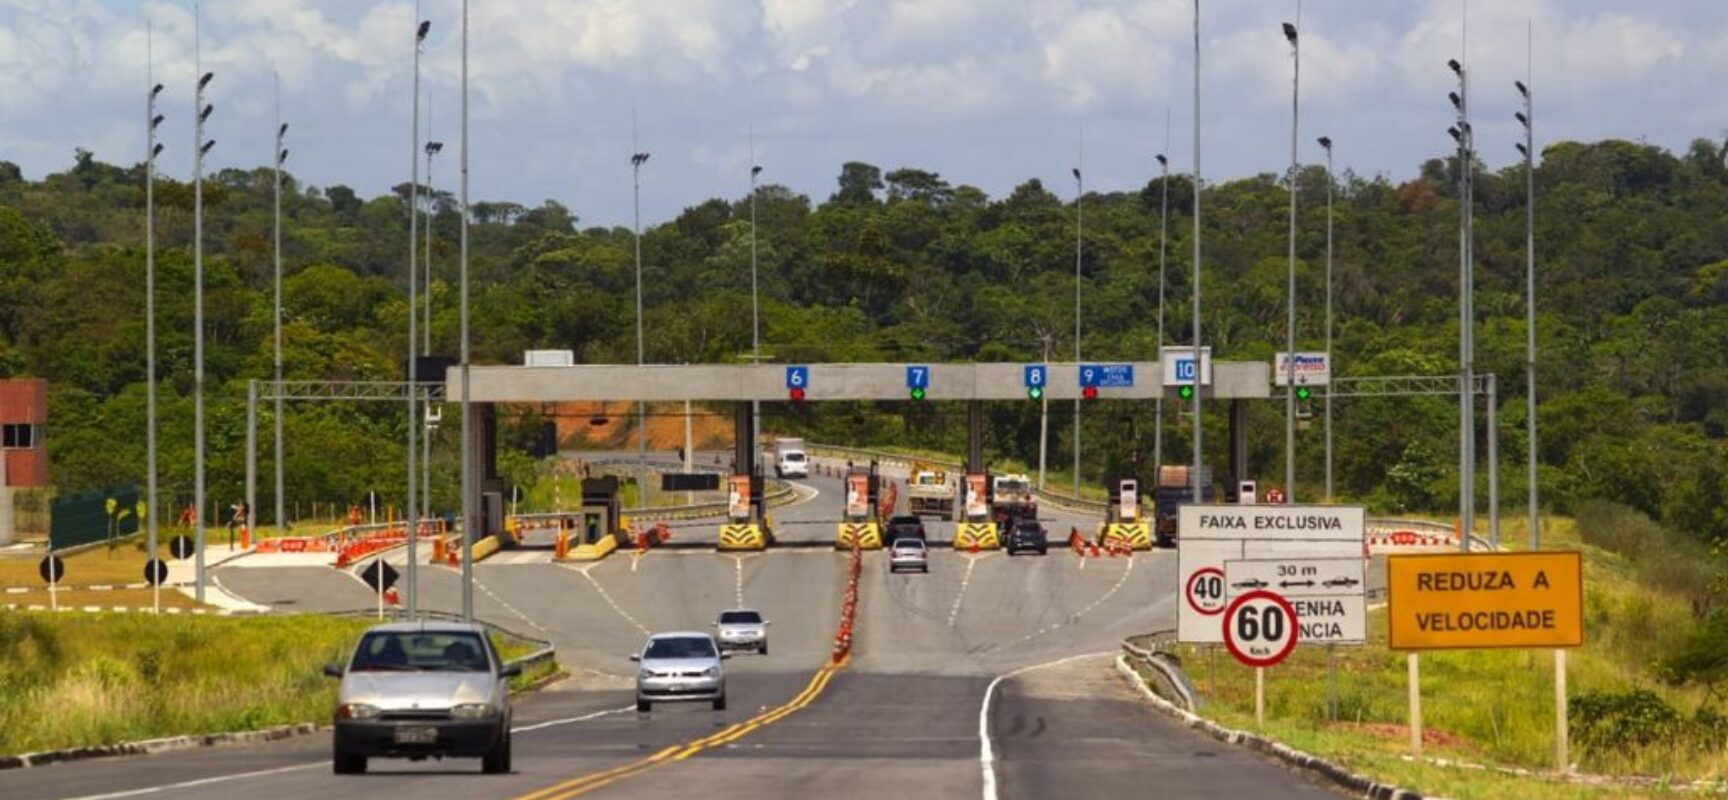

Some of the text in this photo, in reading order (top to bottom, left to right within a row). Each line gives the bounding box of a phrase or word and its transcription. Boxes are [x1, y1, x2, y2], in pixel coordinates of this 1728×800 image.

[791, 369, 802, 386] 6
[912, 369, 923, 385] 7
[1030, 369, 1041, 384] 8
[1084, 369, 1094, 383] 9
[1179, 362, 1195, 377] 10
[1199, 515, 1342, 529] FAIXA EXCLUSIVA
[1277, 565, 1317, 576] 30 m
[1194, 576, 1222, 599] 40
[1417, 570, 1549, 591] REDUZA A
[1237, 605, 1284, 642] 60
[1416, 610, 1555, 632] VELOCIDADE
